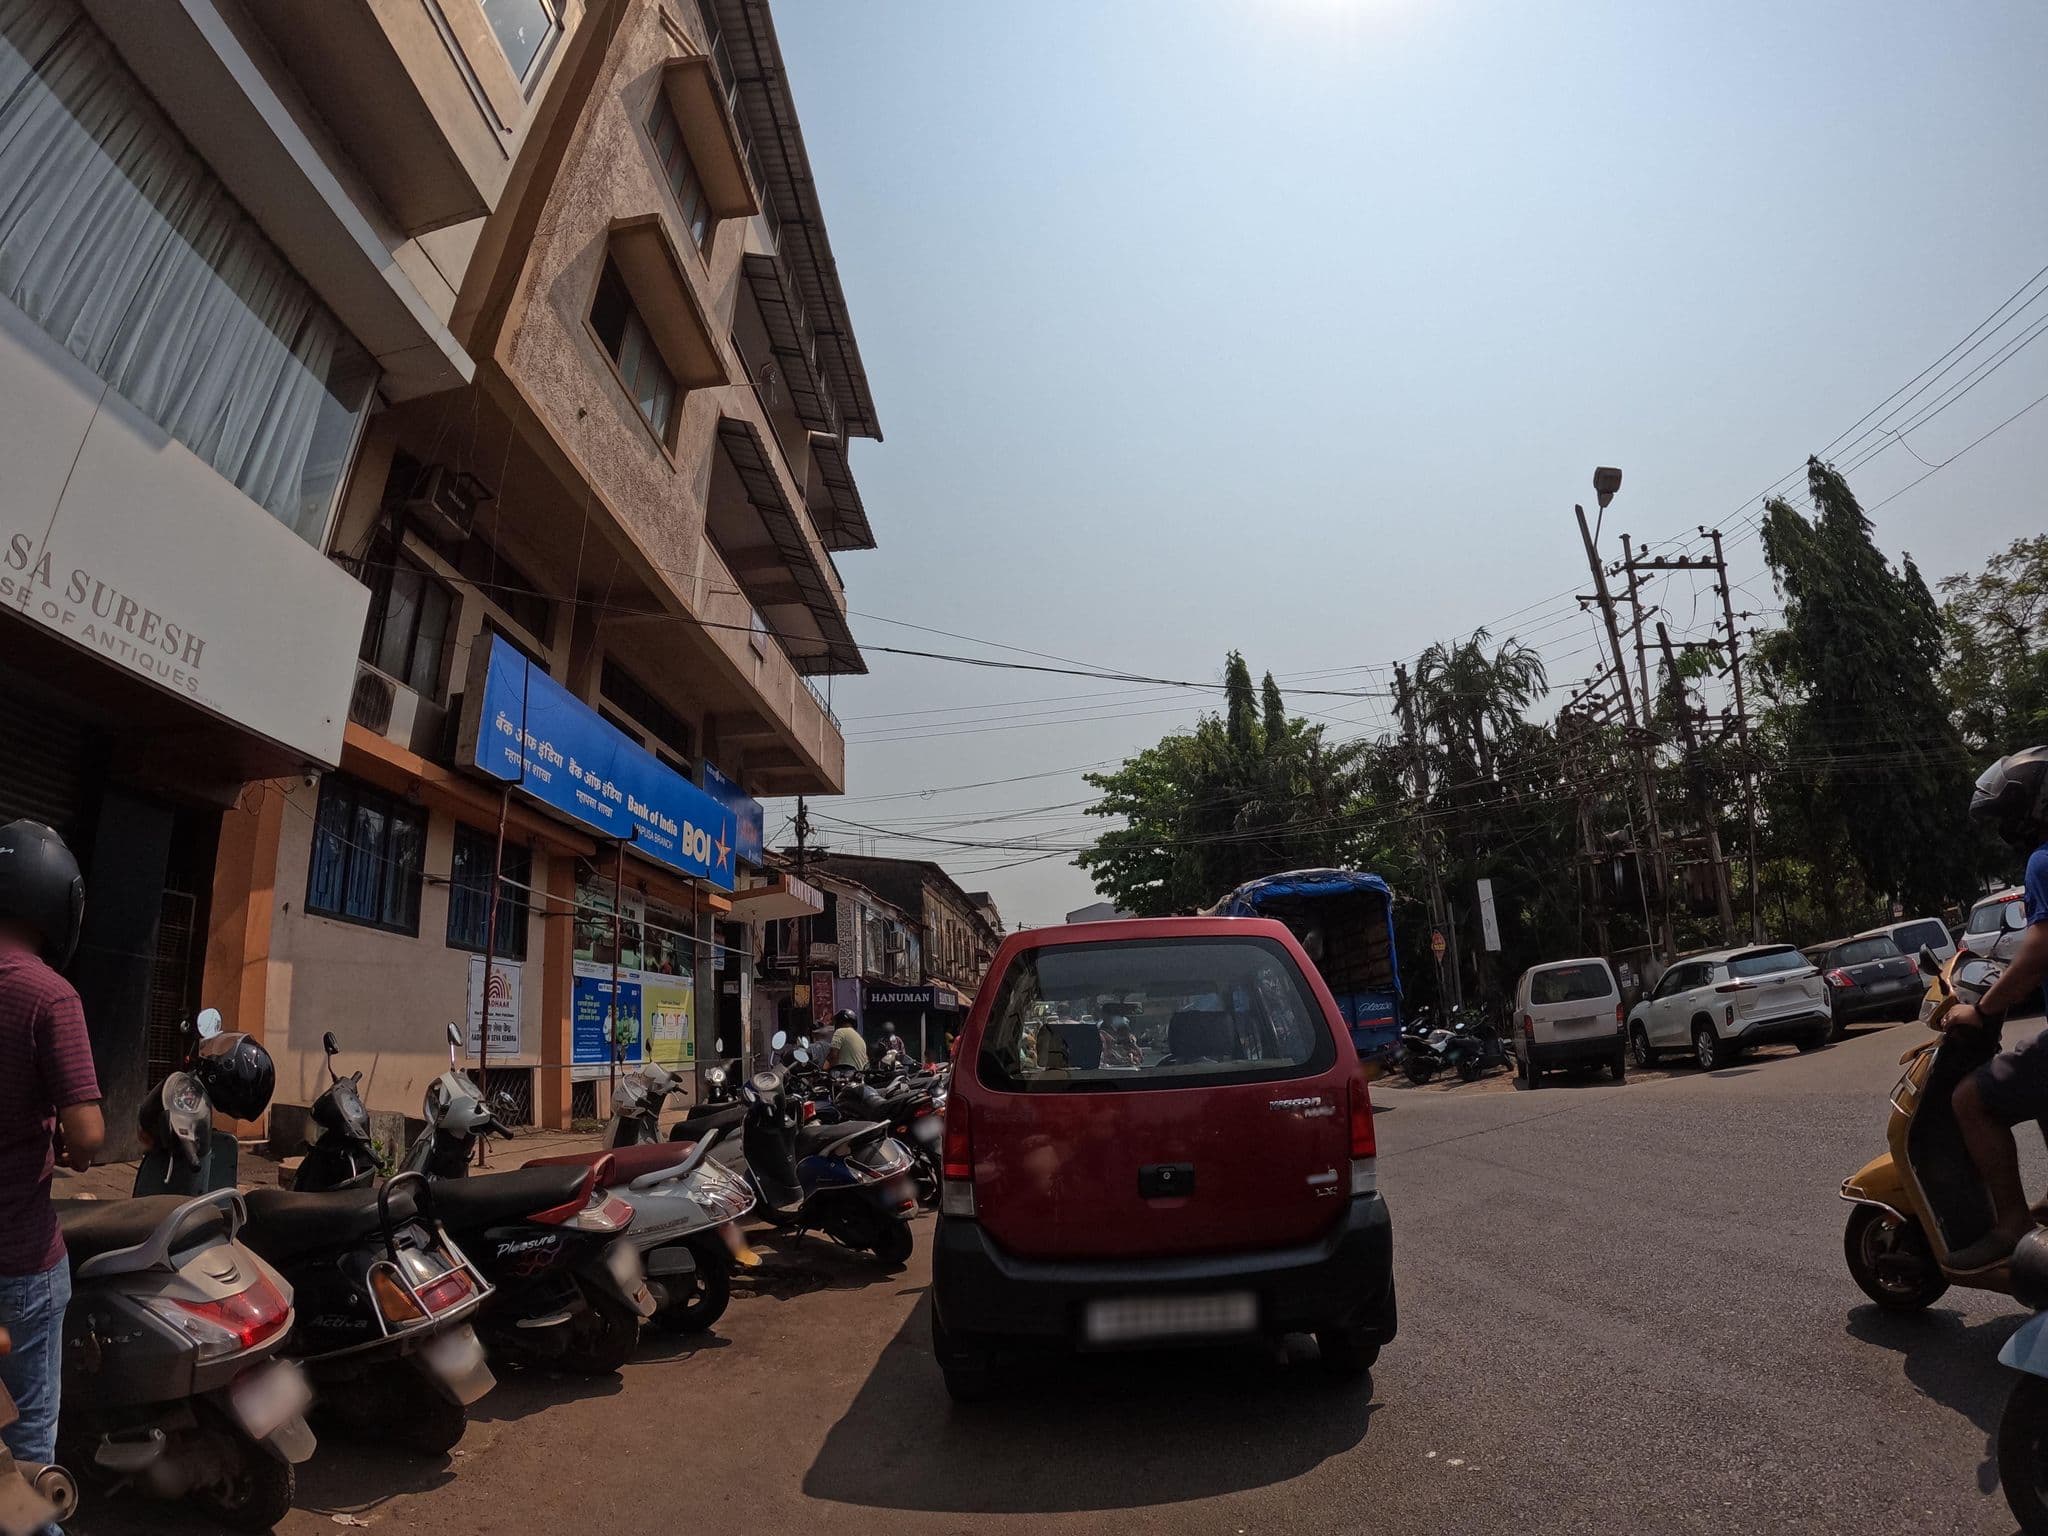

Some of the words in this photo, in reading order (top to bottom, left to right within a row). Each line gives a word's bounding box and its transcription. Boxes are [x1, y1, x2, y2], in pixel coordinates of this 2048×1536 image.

[64, 569, 207, 669] SURESH
[41, 600, 77, 625] OF
[81, 623, 199, 692] ANTIQUES
[538, 740, 564, 769] इंडिया
[627, 794, 649, 821] Bank
[649, 811, 660, 827] of
[659, 813, 678, 837] India
[682, 820, 711, 867] BOI
[871, 992, 931, 1003] HANUMAN
[496, 1234, 557, 1258] Pleasure
[308, 1314, 369, 1329] Activa
